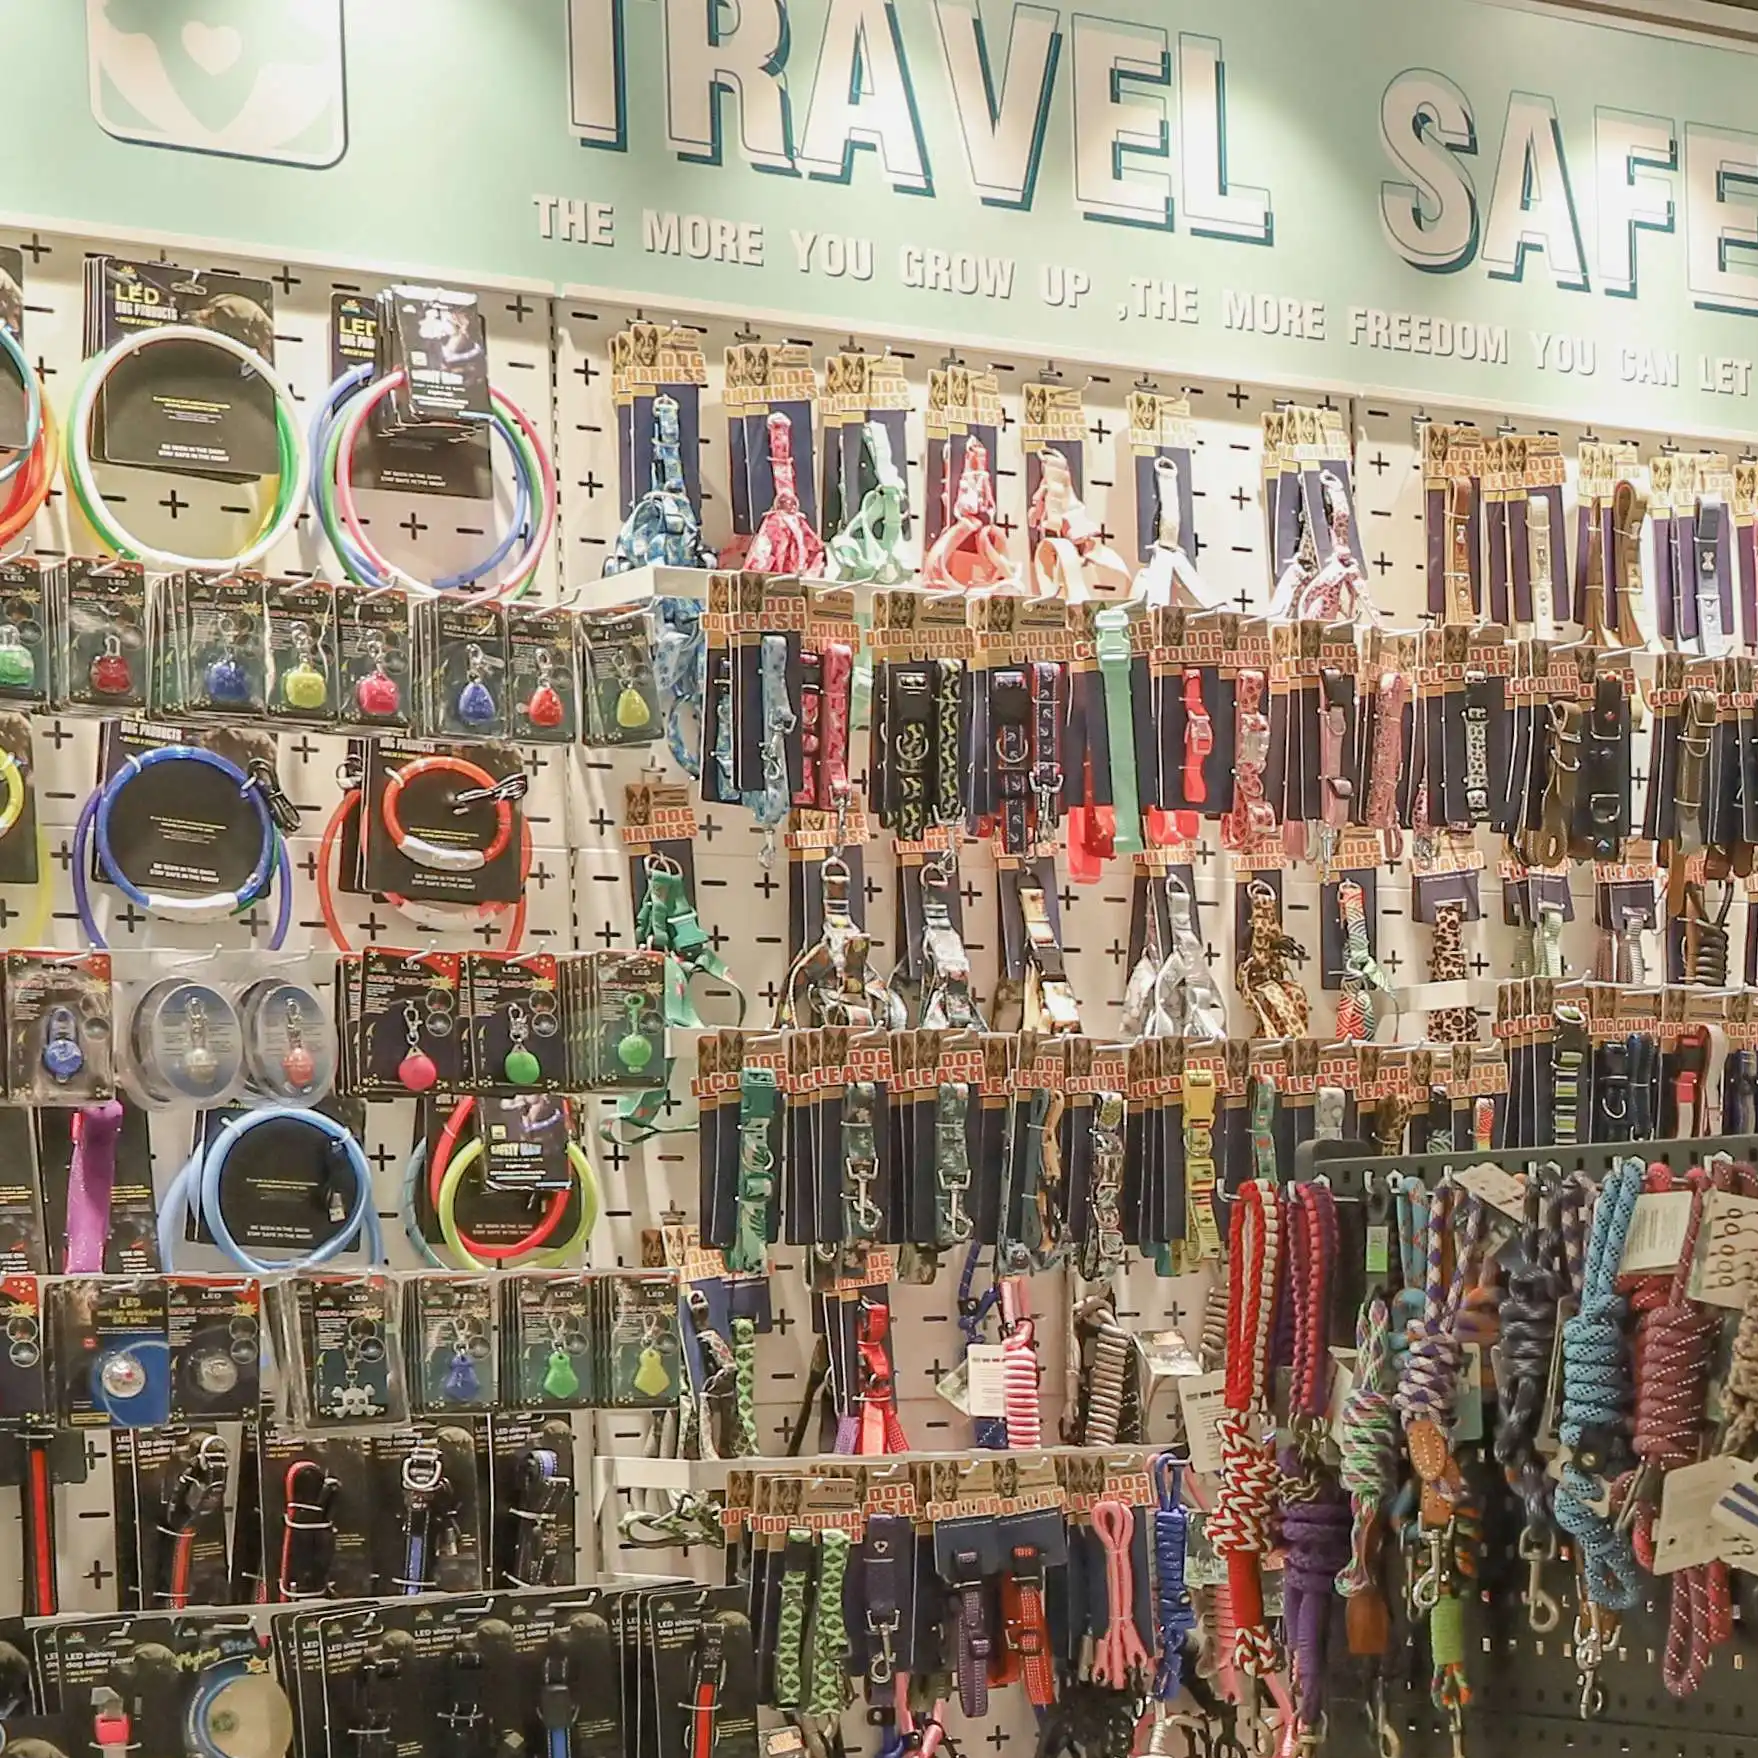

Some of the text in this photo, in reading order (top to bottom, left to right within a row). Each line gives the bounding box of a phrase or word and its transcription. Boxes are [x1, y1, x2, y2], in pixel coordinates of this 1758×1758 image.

[568, 0, 1275, 247] TRAVEL
[114, 283, 160, 305] LED
[533, 195, 615, 248] THE
[642, 206, 764, 268] MORE
[790, 230, 874, 282] YOU
[900, 245, 1015, 302] GROW
[1038, 265, 1092, 310] UP
[1226, 290, 1327, 341] MORE
[1347, 305, 1510, 366] FREEDOM
[1530, 330, 1596, 376] YOU
[1619, 346, 1680, 388] CAN
[1698, 354, 1752, 398] LET
[661, 353, 705, 368] DOG
[626, 366, 706, 383] HARNESS
[771, 369, 814, 384] DOG
[738, 384, 818, 401] HARNESS
[1050, 410, 1084, 425] DOG
[1528, 456, 1566, 472] DOG
[1500, 470, 1567, 488] LEASH
[765, 597, 805, 613] DOG
[733, 613, 805, 631] LEASH
[811, 622, 860, 639] COLLAR
[880, 627, 974, 645] DOG COLLAR
[980, 630, 1074, 649] DOG COLLAR
[1186, 629, 1222, 645] DOG
[1155, 643, 1223, 663] COLLAR
[1550, 662, 1577, 678] DOG
[1528, 677, 1578, 694] COLLAR
[119, 720, 139, 734] DOG
[650, 808, 695, 826] DOG
[622, 823, 698, 843] HARNESS
[1590, 1016, 1658, 1033] DOG COLLAR
[849, 1048, 891, 1065] DOG
[941, 1050, 984, 1068] DOG
[1033, 1056, 1065, 1073] DOG
[814, 1064, 892, 1085] LEASH
[1092, 1060, 1126, 1077] DOG
[1320, 1058, 1357, 1075] DOG
[1378, 1067, 1409, 1083] DOG
[1470, 1064, 1507, 1081] DOG
[906, 1066, 984, 1085] LEASH
[1011, 1071, 1065, 1088] LEASH
[1288, 1074, 1360, 1094] LEASH
[1066, 1077, 1127, 1094] COLLAR
[1355, 1081, 1410, 1099] LEASH
[1447, 1078, 1508, 1098] LEASH
[927, 1500, 1001, 1519] COLLAR
[765, 1511, 862, 1533] DOG COLLAR
[64, 1649, 117, 1662] LED shining
